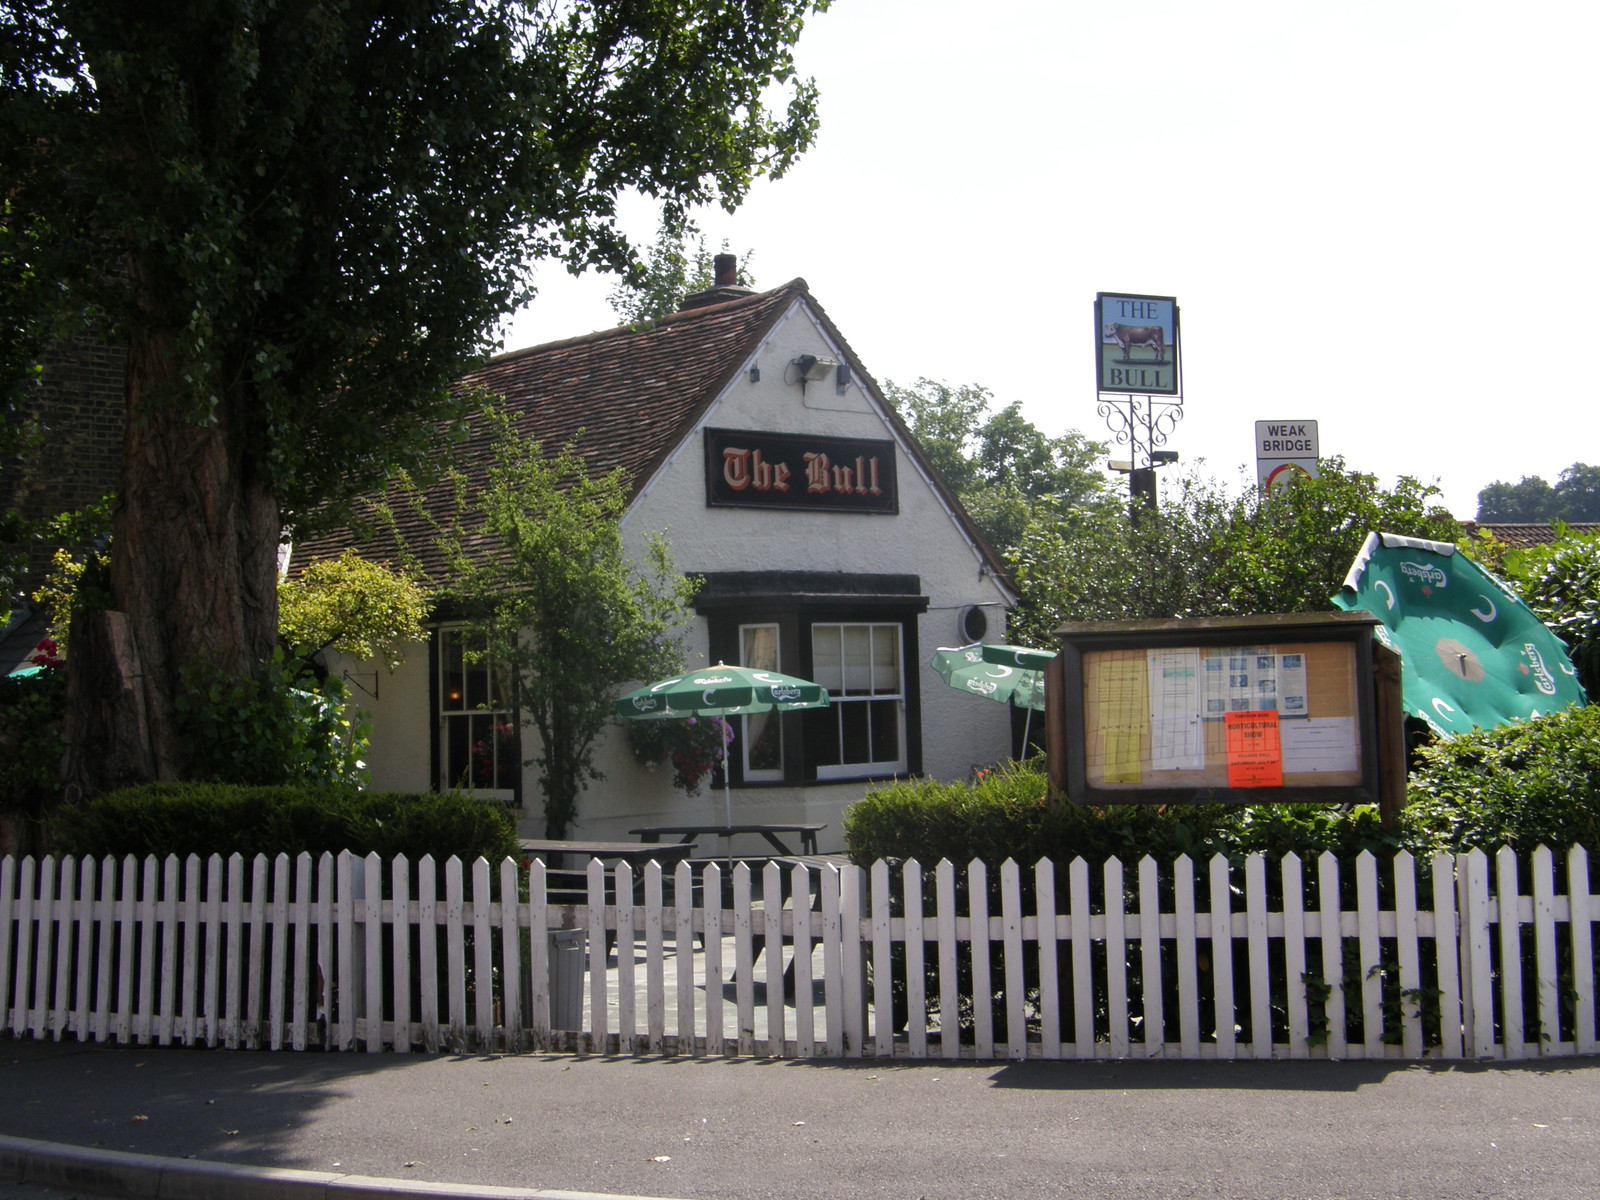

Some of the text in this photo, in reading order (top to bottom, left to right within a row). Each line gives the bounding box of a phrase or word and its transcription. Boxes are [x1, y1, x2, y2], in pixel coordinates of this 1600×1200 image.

[1116, 300, 1158, 320] THE
[1110, 368, 1168, 388] BULL
[1267, 425, 1306, 436] WEAK
[1263, 440, 1312, 451] BRIDGE
[723, 447, 882, 496] The Bull
[1400, 561, 1447, 588] Carlsberg
[1524, 643, 1556, 695] Carlsberg
[769, 685, 801, 701] Carlsberg
[1228, 721, 1277, 730] HORTICULTURAL
